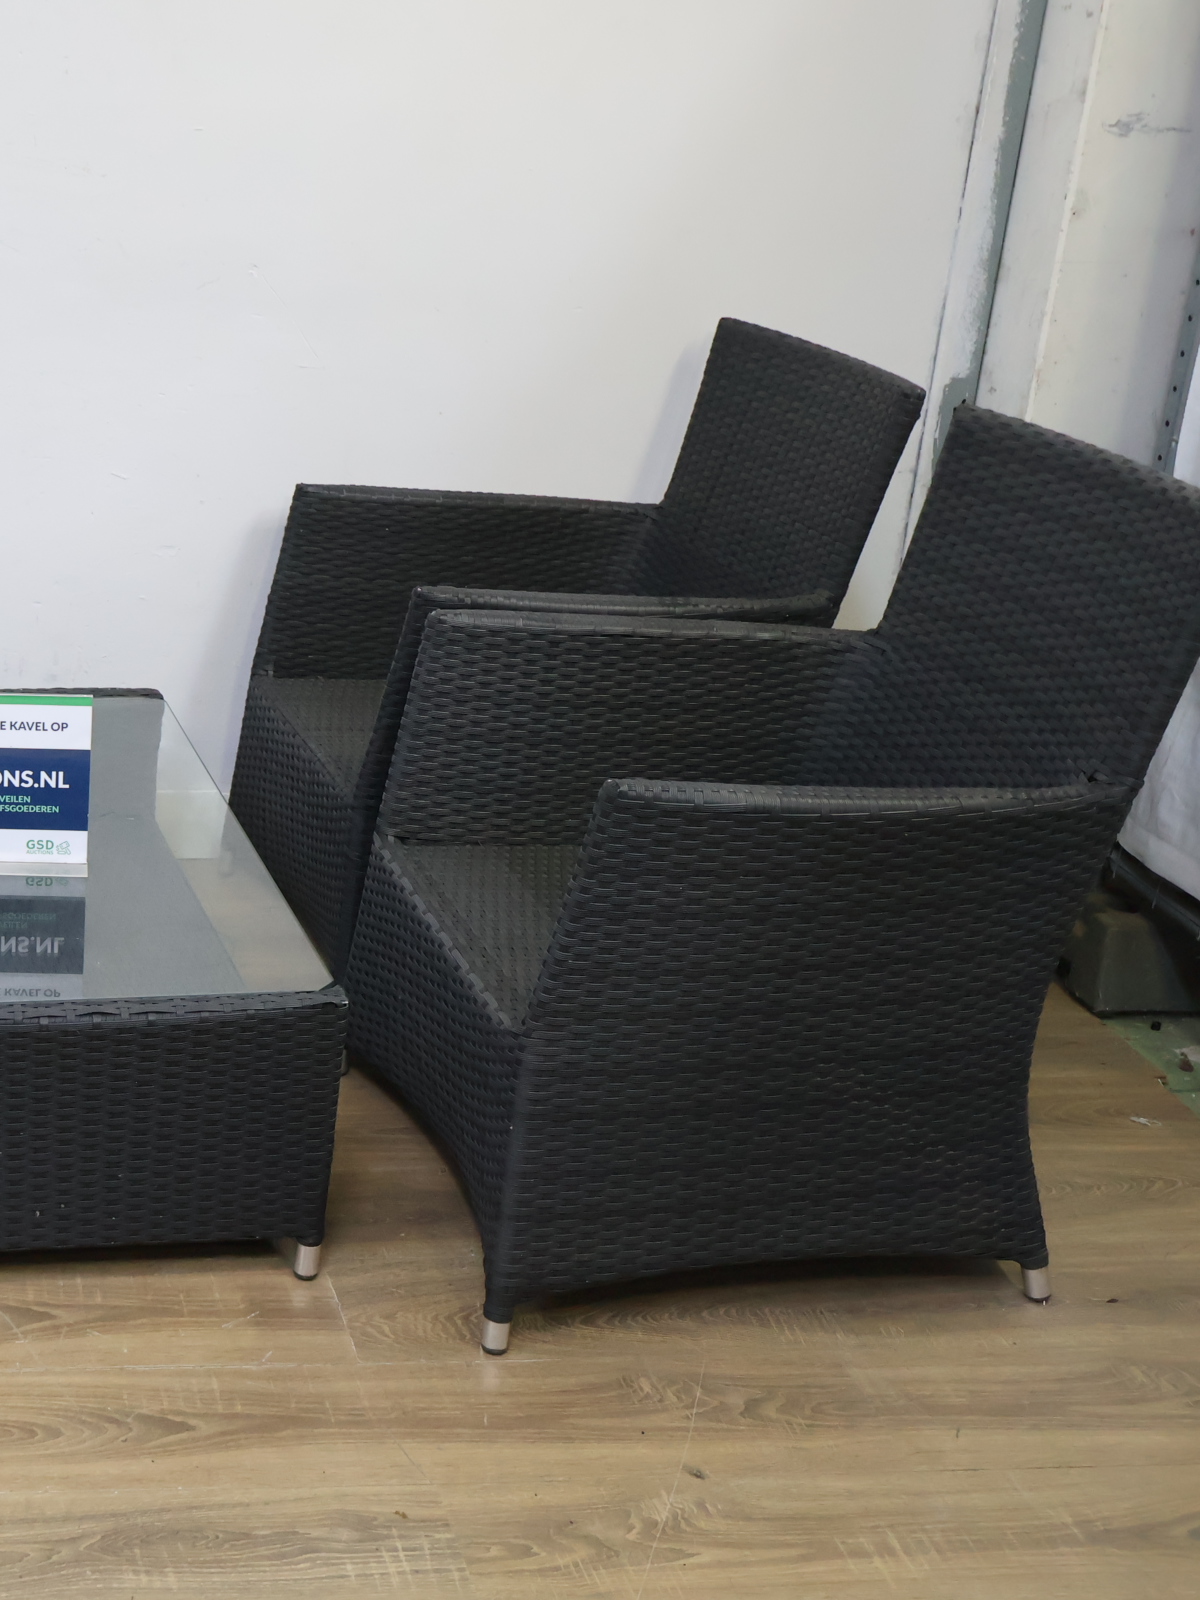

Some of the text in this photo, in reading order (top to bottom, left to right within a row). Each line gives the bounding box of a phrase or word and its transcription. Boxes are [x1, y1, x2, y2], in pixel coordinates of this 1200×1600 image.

[9, 722, 48, 731] KAVEL
[51, 722, 69, 732] OP
[0, 795, 30, 803] VEILEN
[26, 839, 54, 850] GSD
